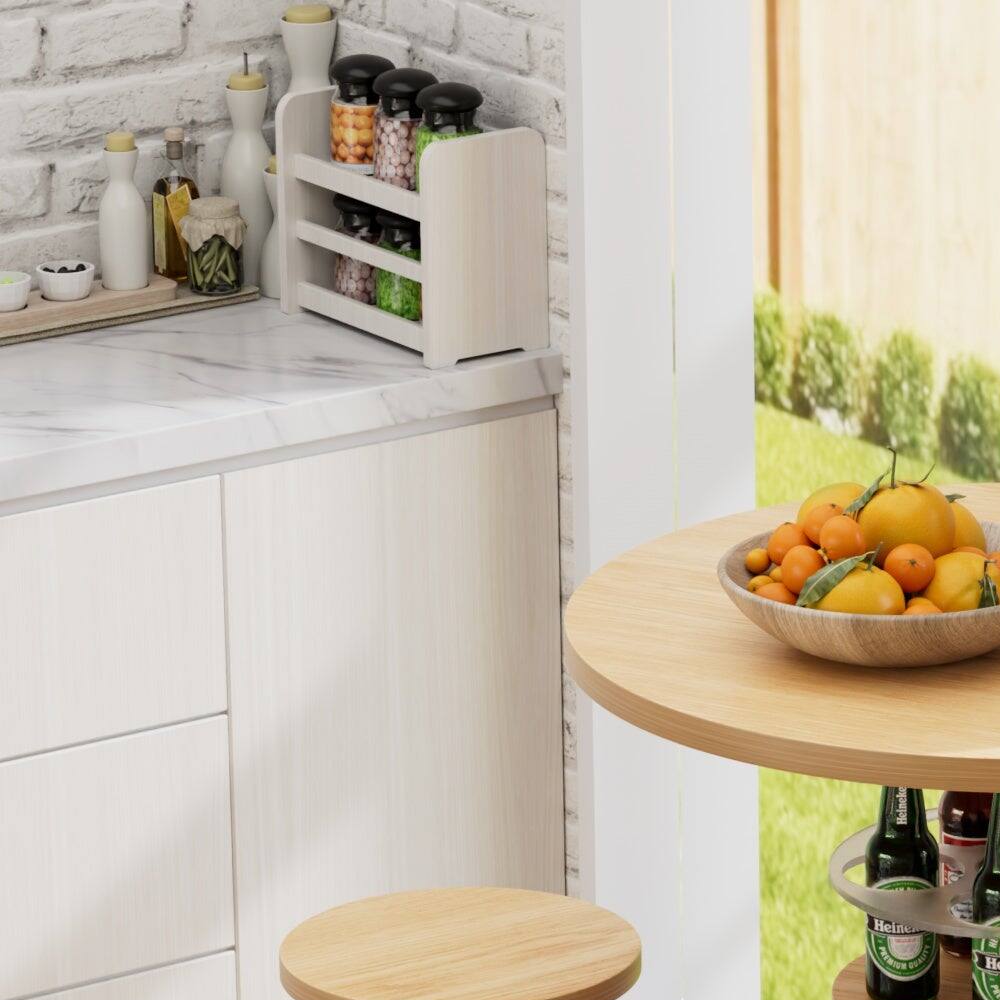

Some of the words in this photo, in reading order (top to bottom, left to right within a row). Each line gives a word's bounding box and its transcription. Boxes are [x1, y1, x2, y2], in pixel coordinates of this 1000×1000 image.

[896, 786, 908, 825] Heineke
[874, 919, 919, 934] Heine
[879, 946, 908, 970] PREMIUM
